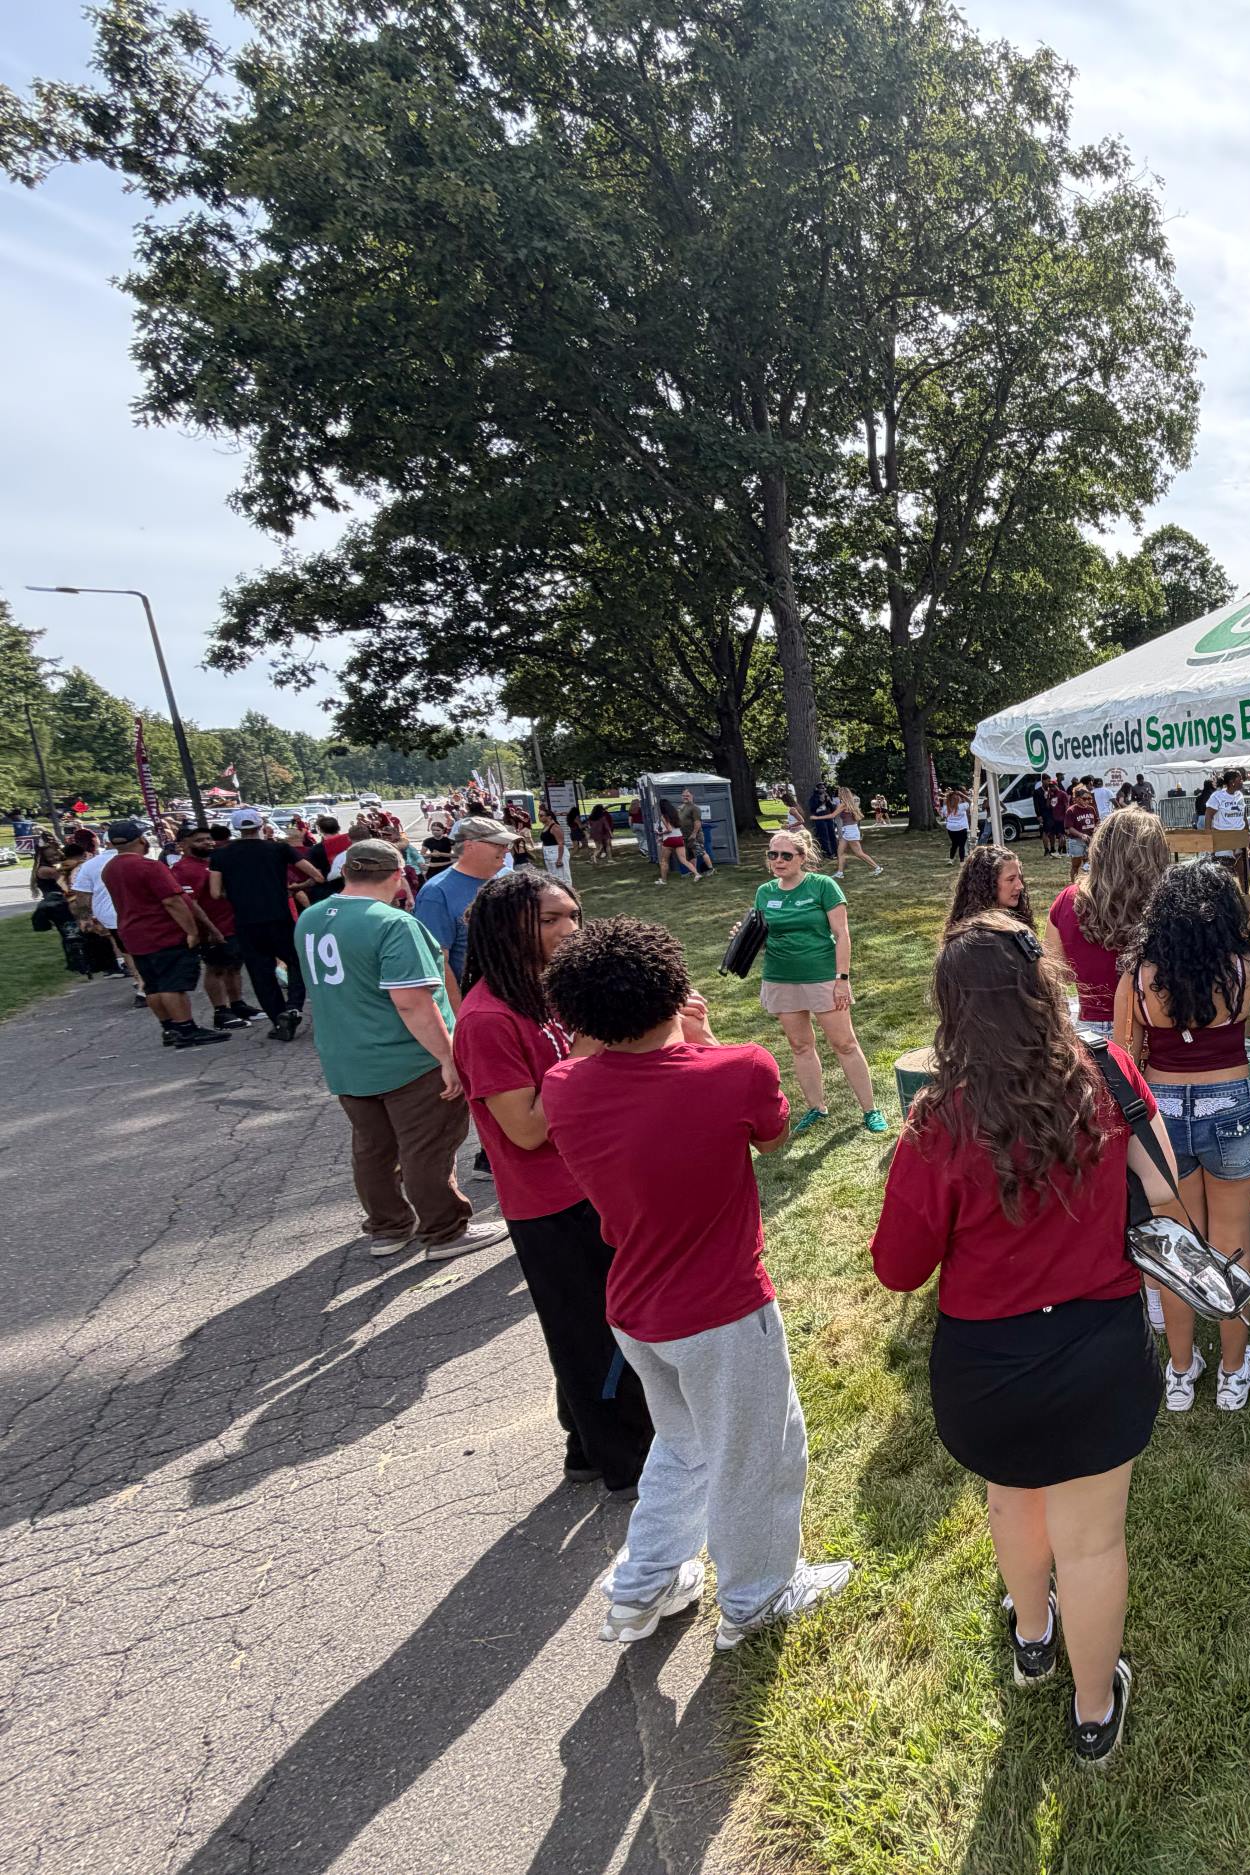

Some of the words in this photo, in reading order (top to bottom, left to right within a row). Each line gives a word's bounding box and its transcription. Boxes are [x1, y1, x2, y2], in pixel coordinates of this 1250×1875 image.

[1051, 719, 1143, 761] Greenfield
[1146, 710, 1237, 754] Savings
[305, 933, 345, 985] 19
